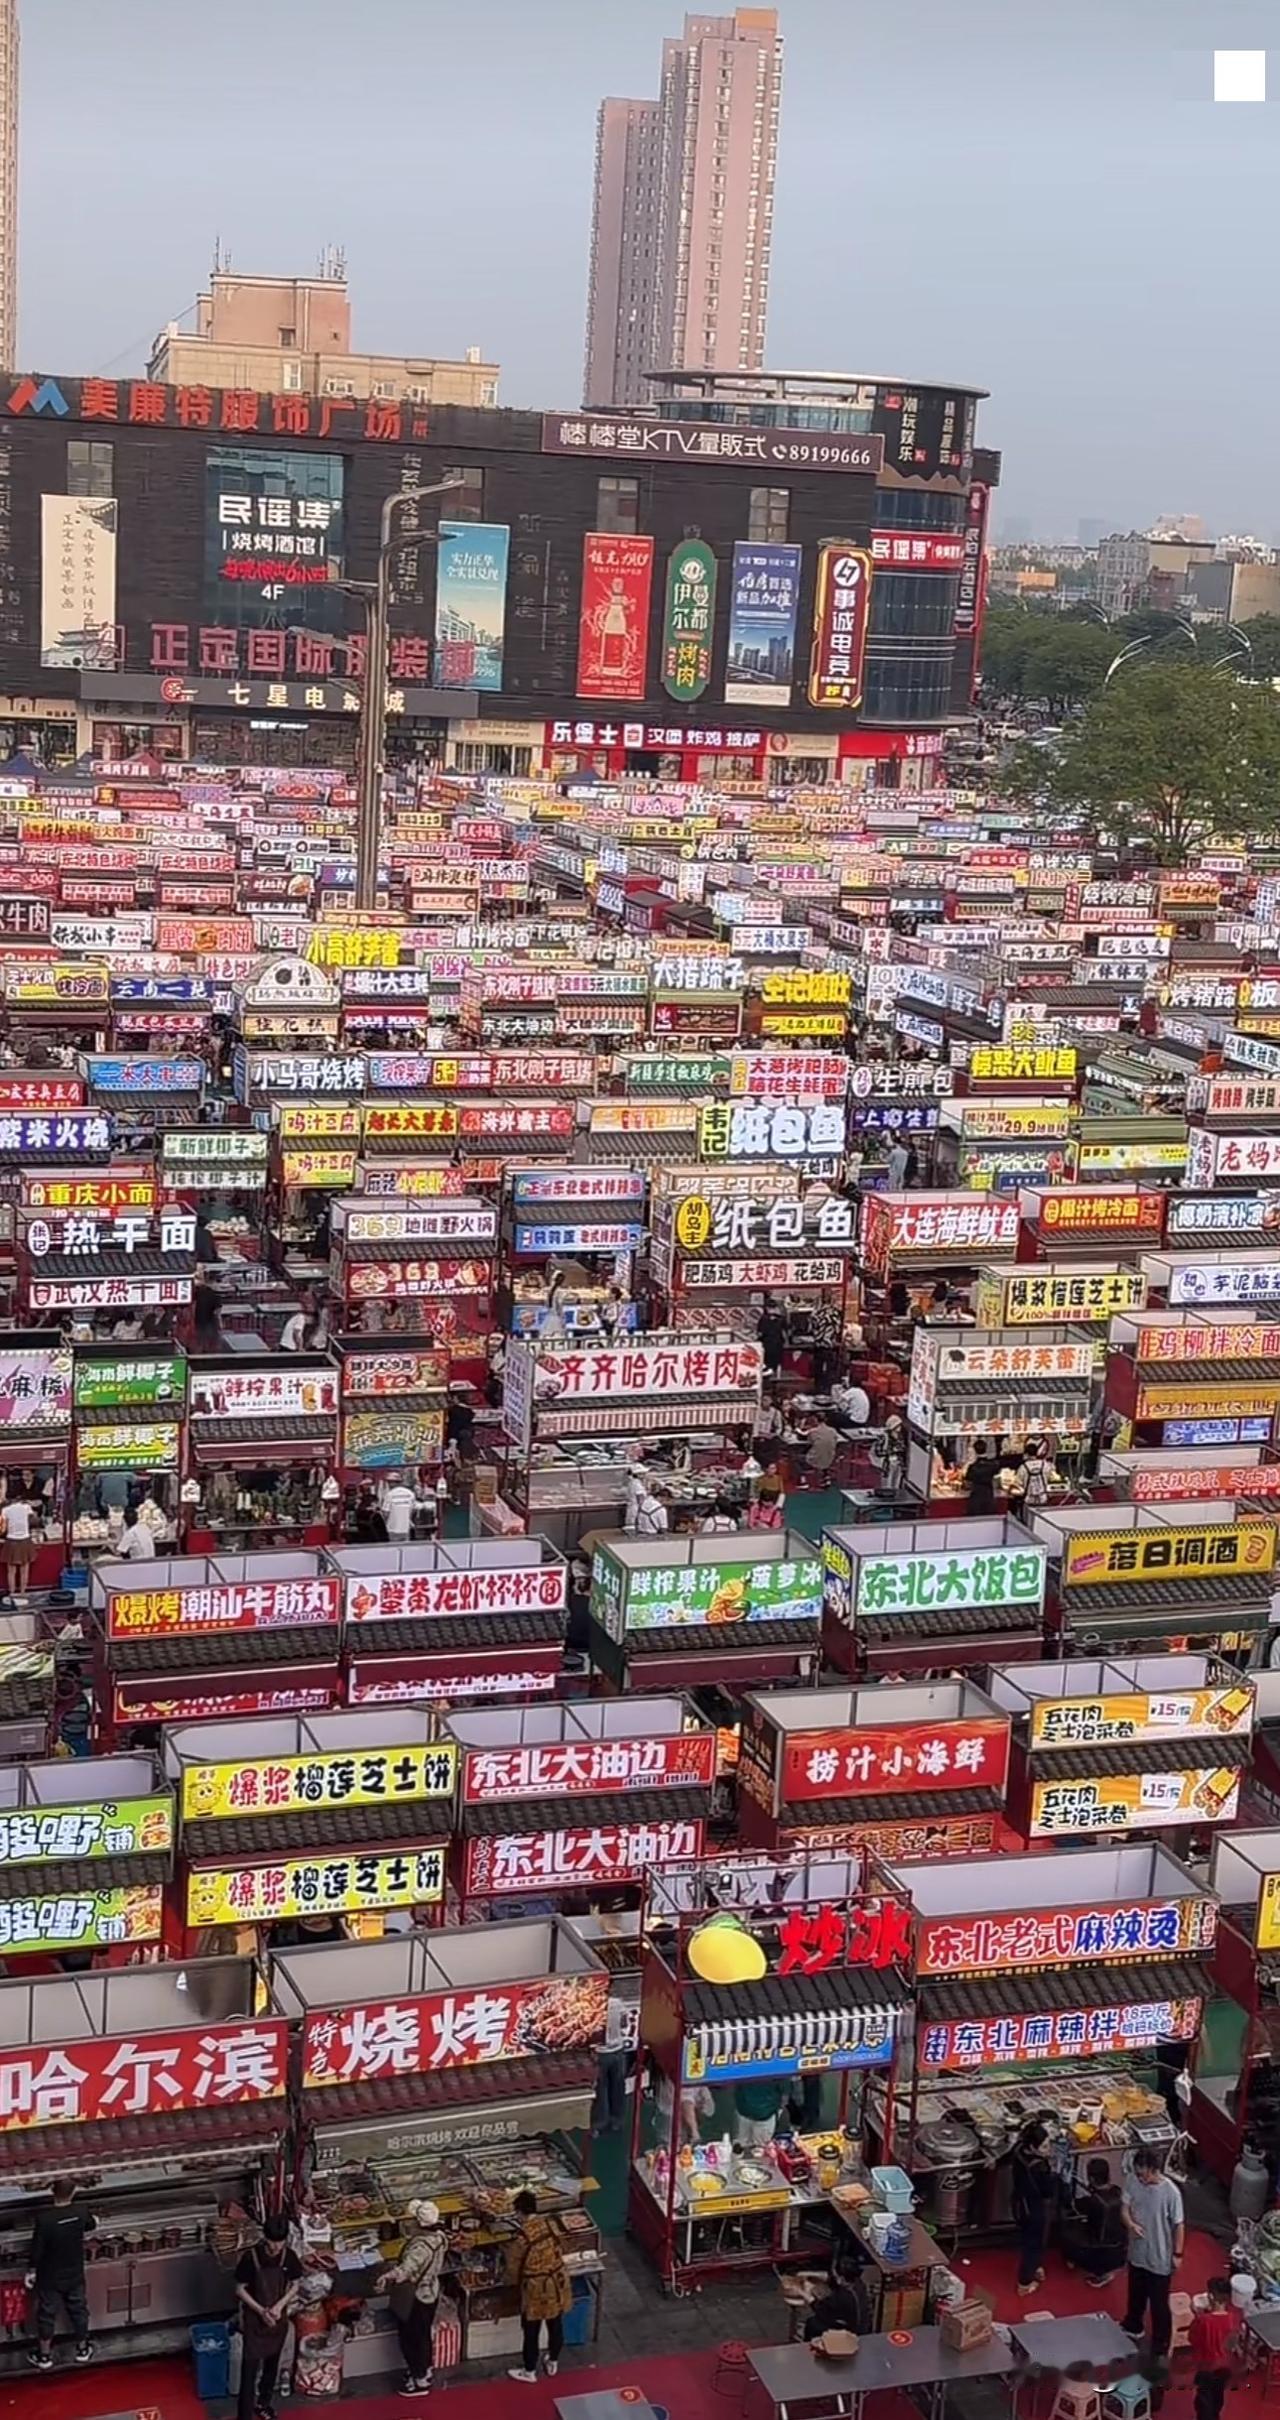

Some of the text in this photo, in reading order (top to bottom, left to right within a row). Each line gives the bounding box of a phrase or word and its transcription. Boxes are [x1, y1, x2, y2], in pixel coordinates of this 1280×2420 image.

[80, 379, 402, 439] 美廉特服饰广场
[788, 442, 871, 466] 89199666
[220, 494, 331, 530] 民谣集
[231, 531, 317, 556] 烧烤酒馆
[261, 583, 286, 601] 4F
[676, 640, 698, 688] 烤肉
[551, 721, 619, 746] 乐堡士
[116, 979, 208, 998] 云南一绝
[1172, 979, 1240, 1010] 烤猪蹄
[254, 1058, 366, 1090] 小马哥烧烤
[873, 1065, 954, 1098] 生煎包
[0, 1118, 110, 1149] 紫米火烧
[287, 1110, 356, 1133] 鸡汁豆腐
[703, 1106, 727, 1155] 韦记
[729, 1103, 845, 1154] 纸包鱼
[46, 1183, 155, 1205] 重庆小面
[31, 1224, 47, 1252] 张记
[62, 1214, 197, 1255] 热干面
[711, 1195, 856, 1250] 纸包鱼
[892, 1204, 1018, 1247] 大连海鲜鱿鱼
[684, 1258, 842, 1286] 肥肠鸡 大虾鸡 花蛤鸡
[54, 1279, 179, 1305] 武汉热干面
[1010, 1278, 1144, 1308] 爆浆榴莲芝士饼
[86, 1362, 176, 1382] 海南鲜椰子
[560, 1350, 740, 1393] 齐齐哈尔烤肉
[967, 1347, 1077, 1373] 云朵舒芙蕾
[224, 1377, 303, 1398] 鲜榨果汁
[1106, 1535, 1240, 1572] 落日调酒
[378, 1568, 565, 1616] 蟹黄龙虾杯杯面
[630, 1569, 721, 1597] 鲜榨果汁
[750, 1561, 822, 1589] 菠萝冰
[864, 1552, 1041, 1608] 东北大饭包
[114, 1579, 335, 1628] 爆烤潮汕牛筋丸
[1043, 1704, 1103, 1724] 五花肉
[1041, 1720, 1136, 1743] 芝士泡菜卷
[470, 1740, 667, 1790] 东北大油边
[806, 1737, 986, 1785] 捞汁小海鲜
[228, 1752, 451, 1808] 爆浆榴莲芝士饼
[1043, 1785, 1098, 1806] 五花肉
[1039, 1803, 1128, 1829] 芝士泡菜卷
[491, 1821, 697, 1879] 东北大油边
[228, 1854, 441, 1908] 爆浆榴莲芝士饼
[777, 1895, 913, 1977] 炒冰
[926, 1905, 1182, 1972] 东北老式麻辣烫
[307, 2019, 338, 2079] 特色
[341, 1992, 512, 2077] 烧烤
[953, 2010, 1120, 2056] 东北麻辣拌
[0, 2029, 280, 2119] 哈尔滨
